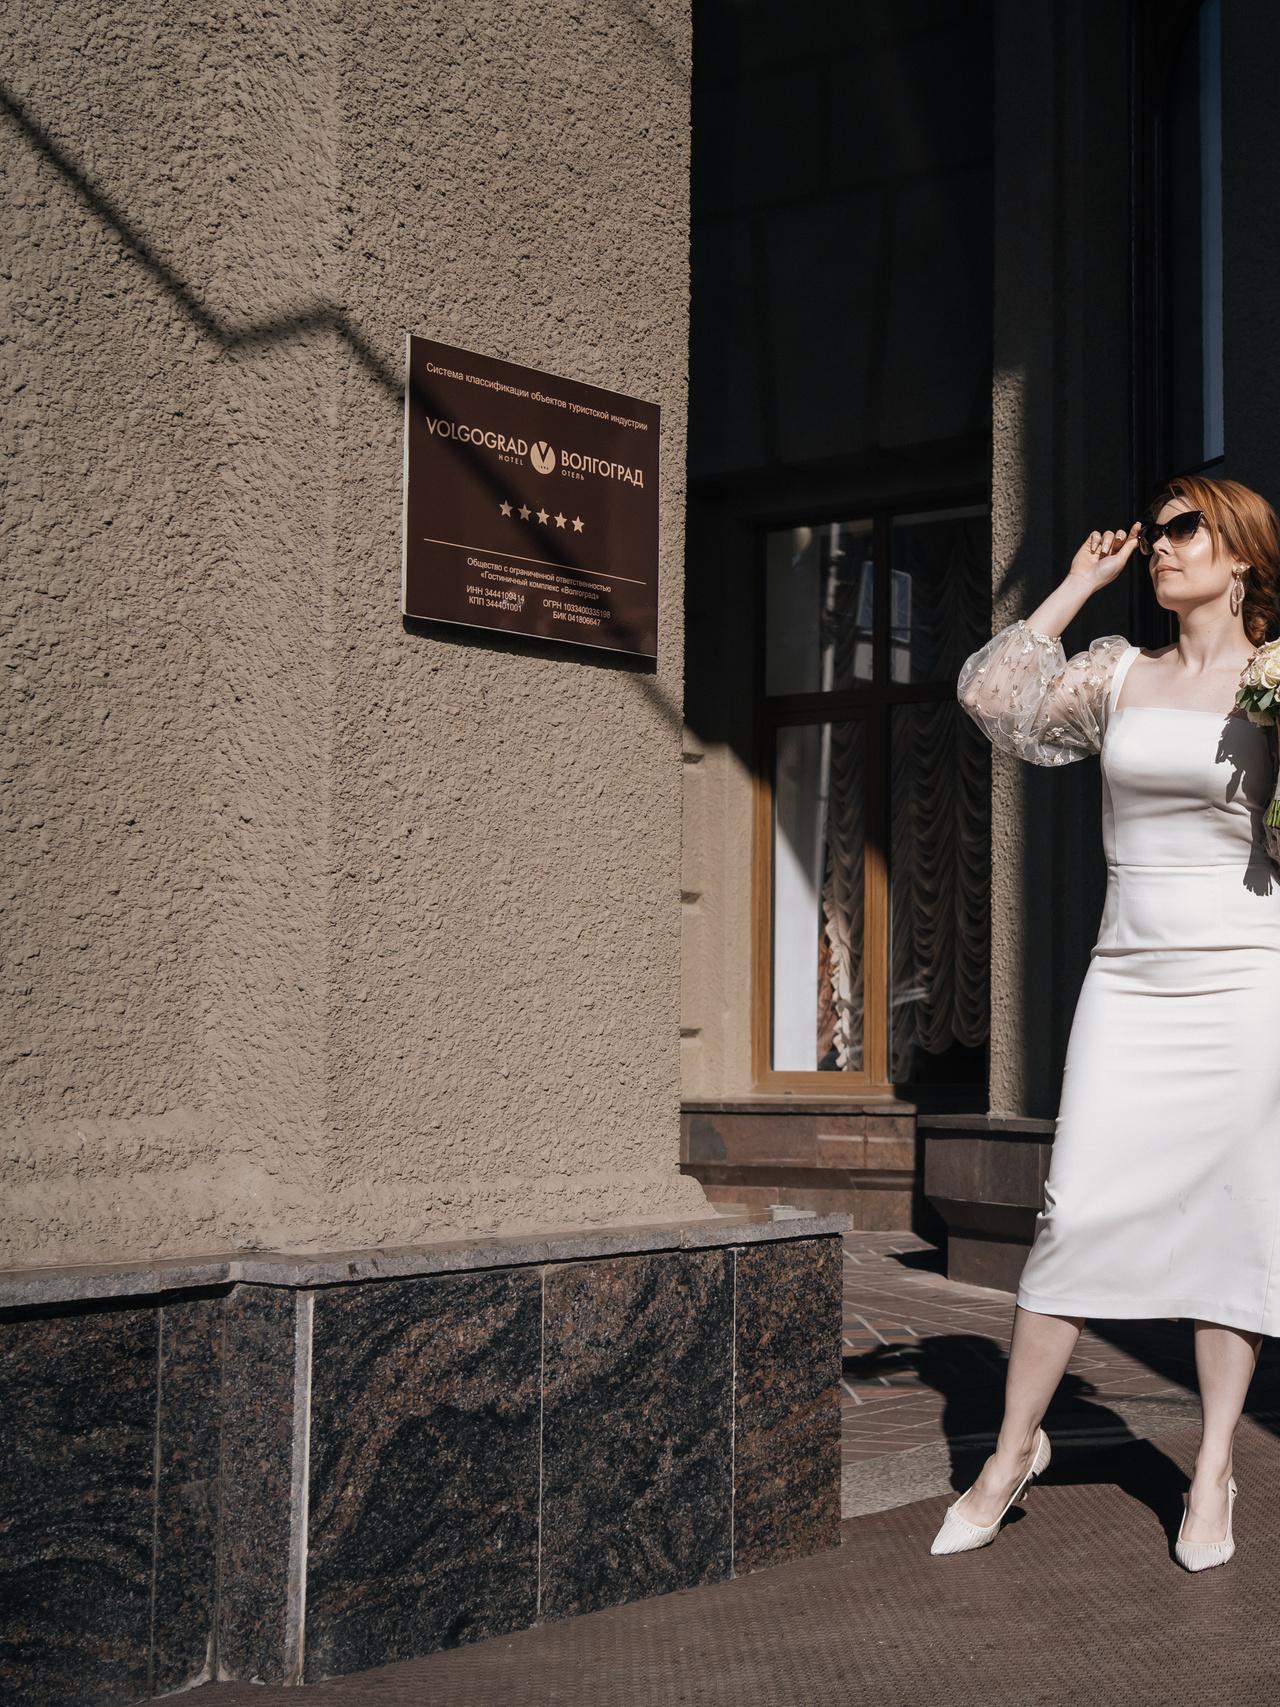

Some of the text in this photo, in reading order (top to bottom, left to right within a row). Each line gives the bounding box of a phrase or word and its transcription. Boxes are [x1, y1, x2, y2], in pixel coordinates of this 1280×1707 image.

[426, 362, 648, 431] Система классификации объектов туристской индустрии
[425, 416, 528, 456] VOLGOGRAD
[498, 454, 523, 466] HOTEL
[561, 450, 644, 488] ВОЛГОГРАД
[561, 469, 585, 481] ОТЕЛЬ
[467, 557, 503, 573] Общество
[509, 566, 555, 582] ограниченной
[555, 575, 612, 593] ответственностью
[466, 585, 483, 596] ИНН
[480, 571, 600, 601] «Гостиничный комплекс «Волгоград»
[468, 595, 485, 606] КПП
[542, 598, 562, 610] ОГРН
[552, 611, 567, 621] БИК
